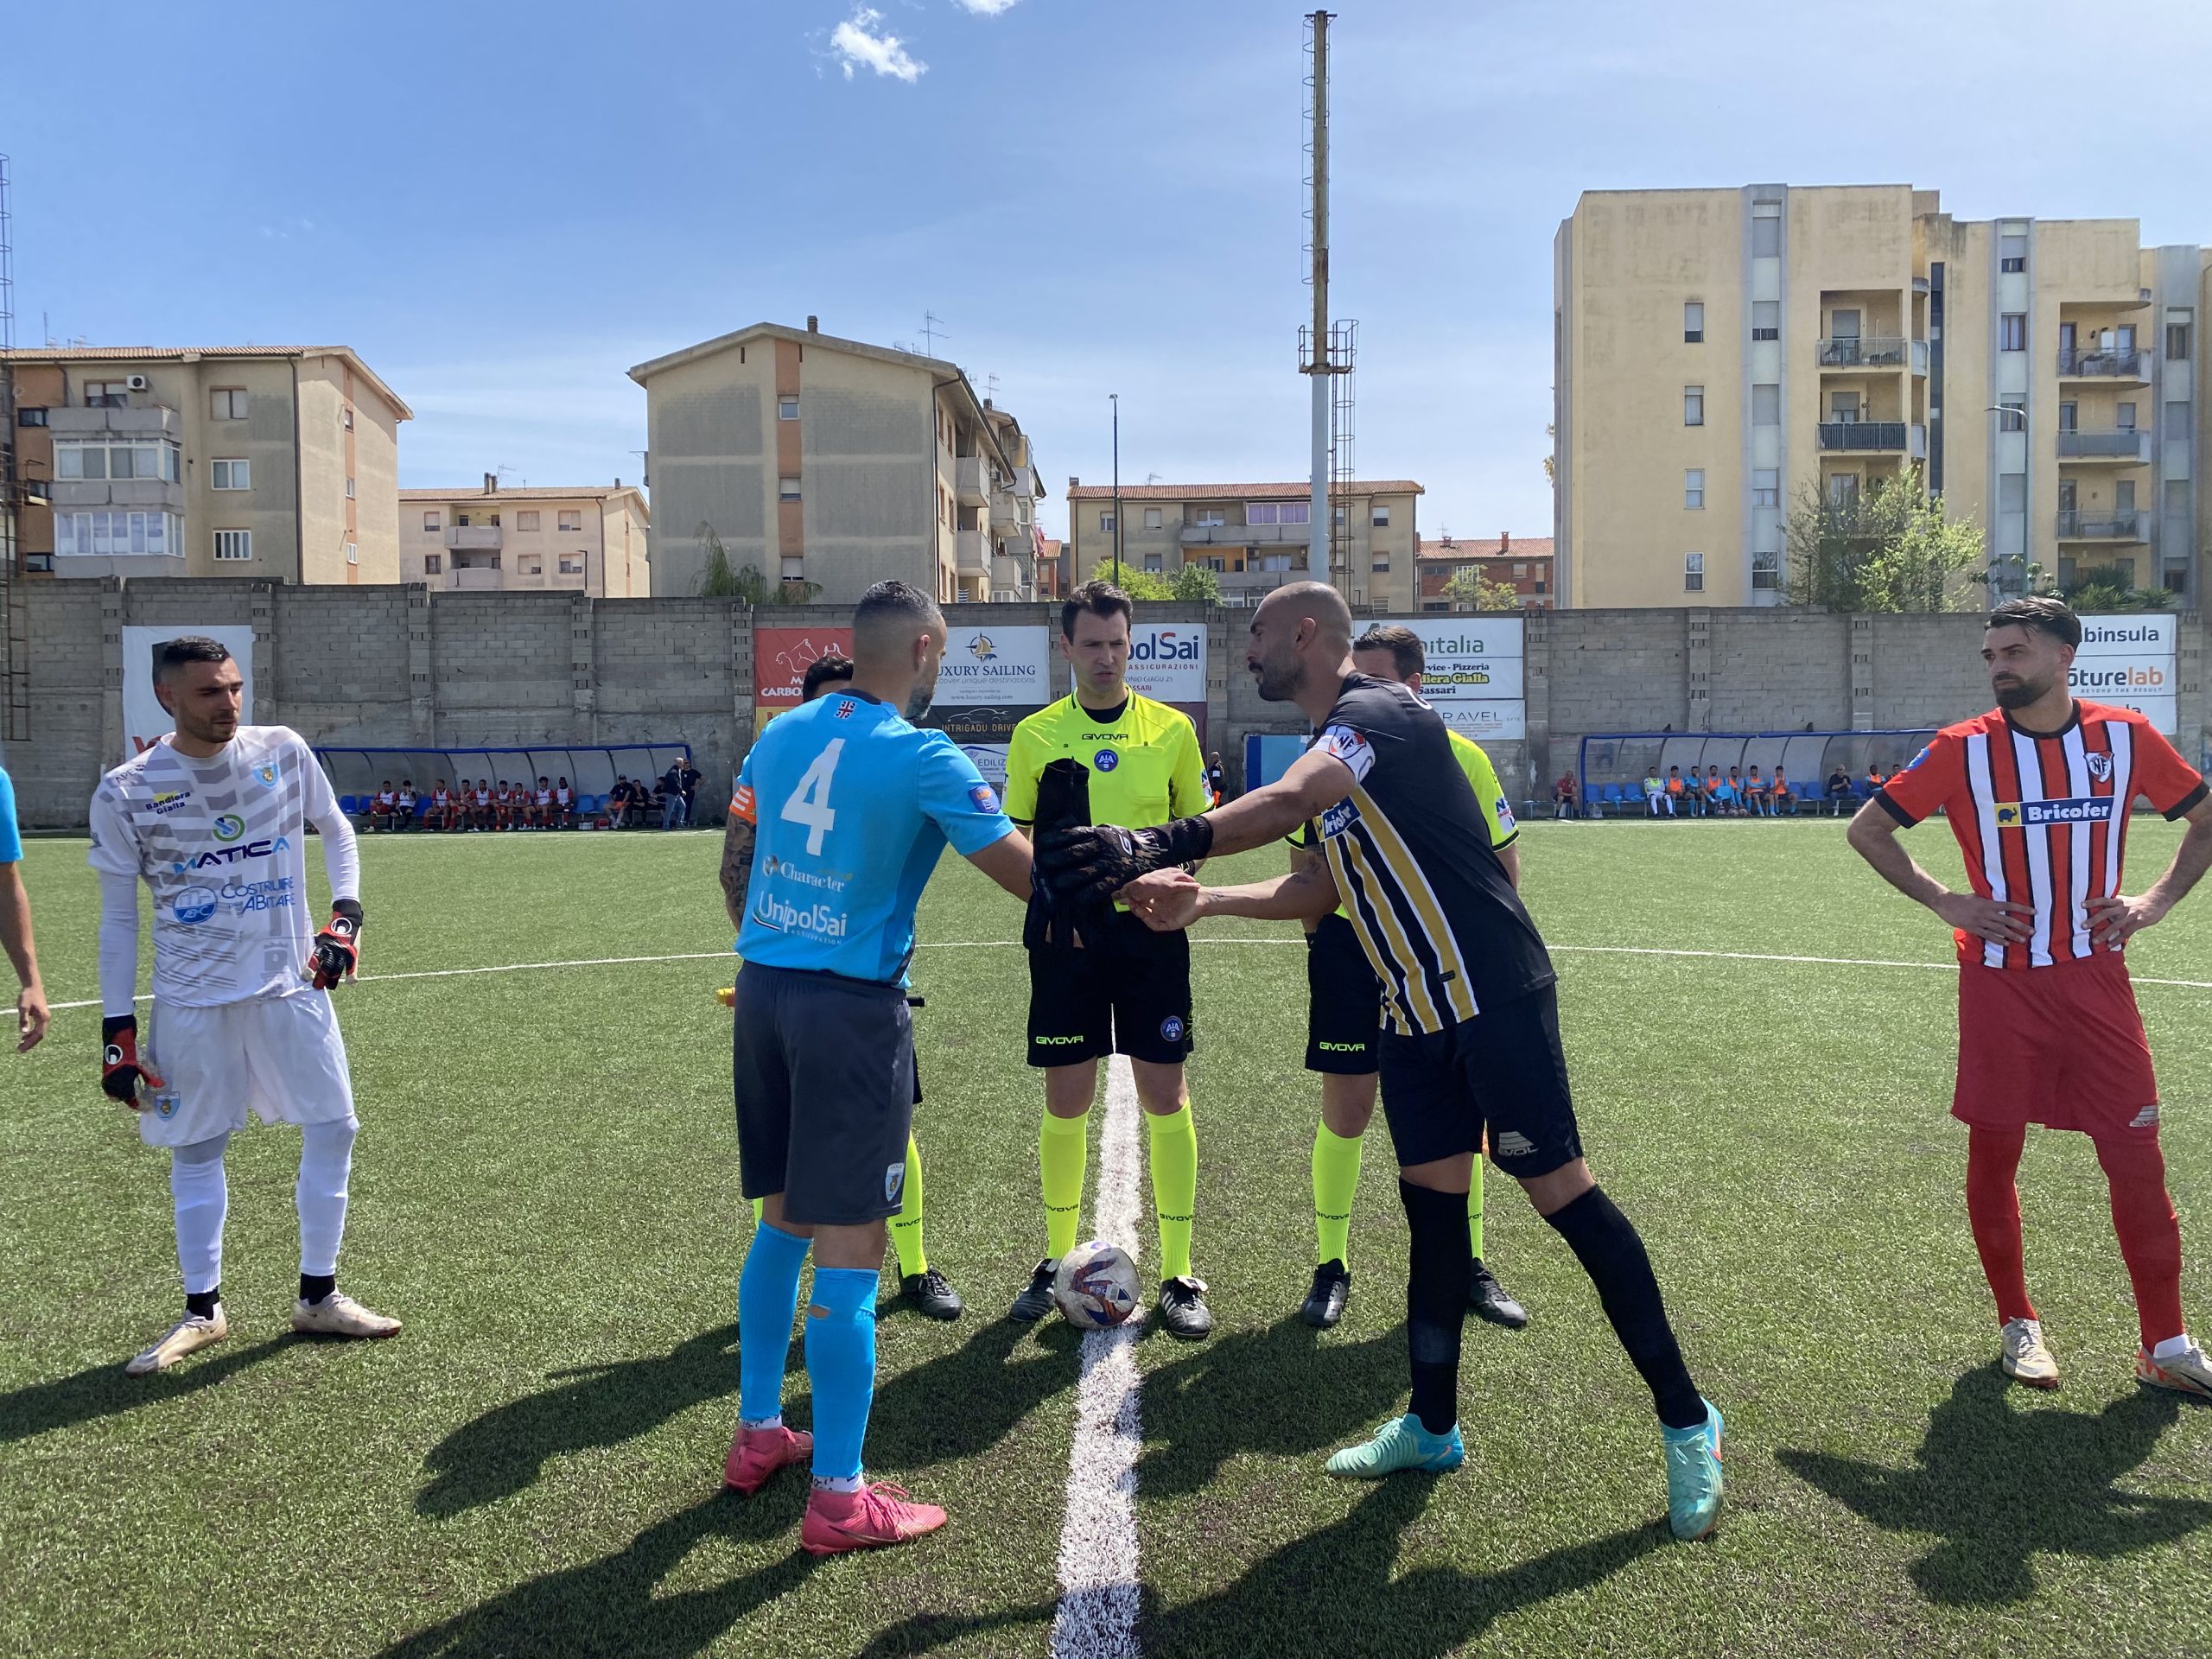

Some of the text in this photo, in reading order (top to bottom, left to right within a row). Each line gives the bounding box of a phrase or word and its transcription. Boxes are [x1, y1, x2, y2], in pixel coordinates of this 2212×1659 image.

[2081, 626, 2159, 643] binsula
[982, 665, 1036, 676] SAILING
[1452, 672, 1490, 684] Gialla
[1418, 686, 1456, 695] Sassari
[941, 723, 988, 733] INTRIGADU
[145, 791, 192, 810] Bandiera
[781, 738, 846, 856] 4
[156, 800, 186, 815] Gialla
[2027, 802, 2109, 821] Bricofer
[173, 836, 290, 875] MATICA
[781, 861, 845, 893] Character
[759, 890, 848, 938] UnipolSai
[1036, 1036, 1084, 1046] GIVOVA
[1319, 1041, 1365, 1052] GIVOVA
[895, 1217, 922, 1228] GIVO
